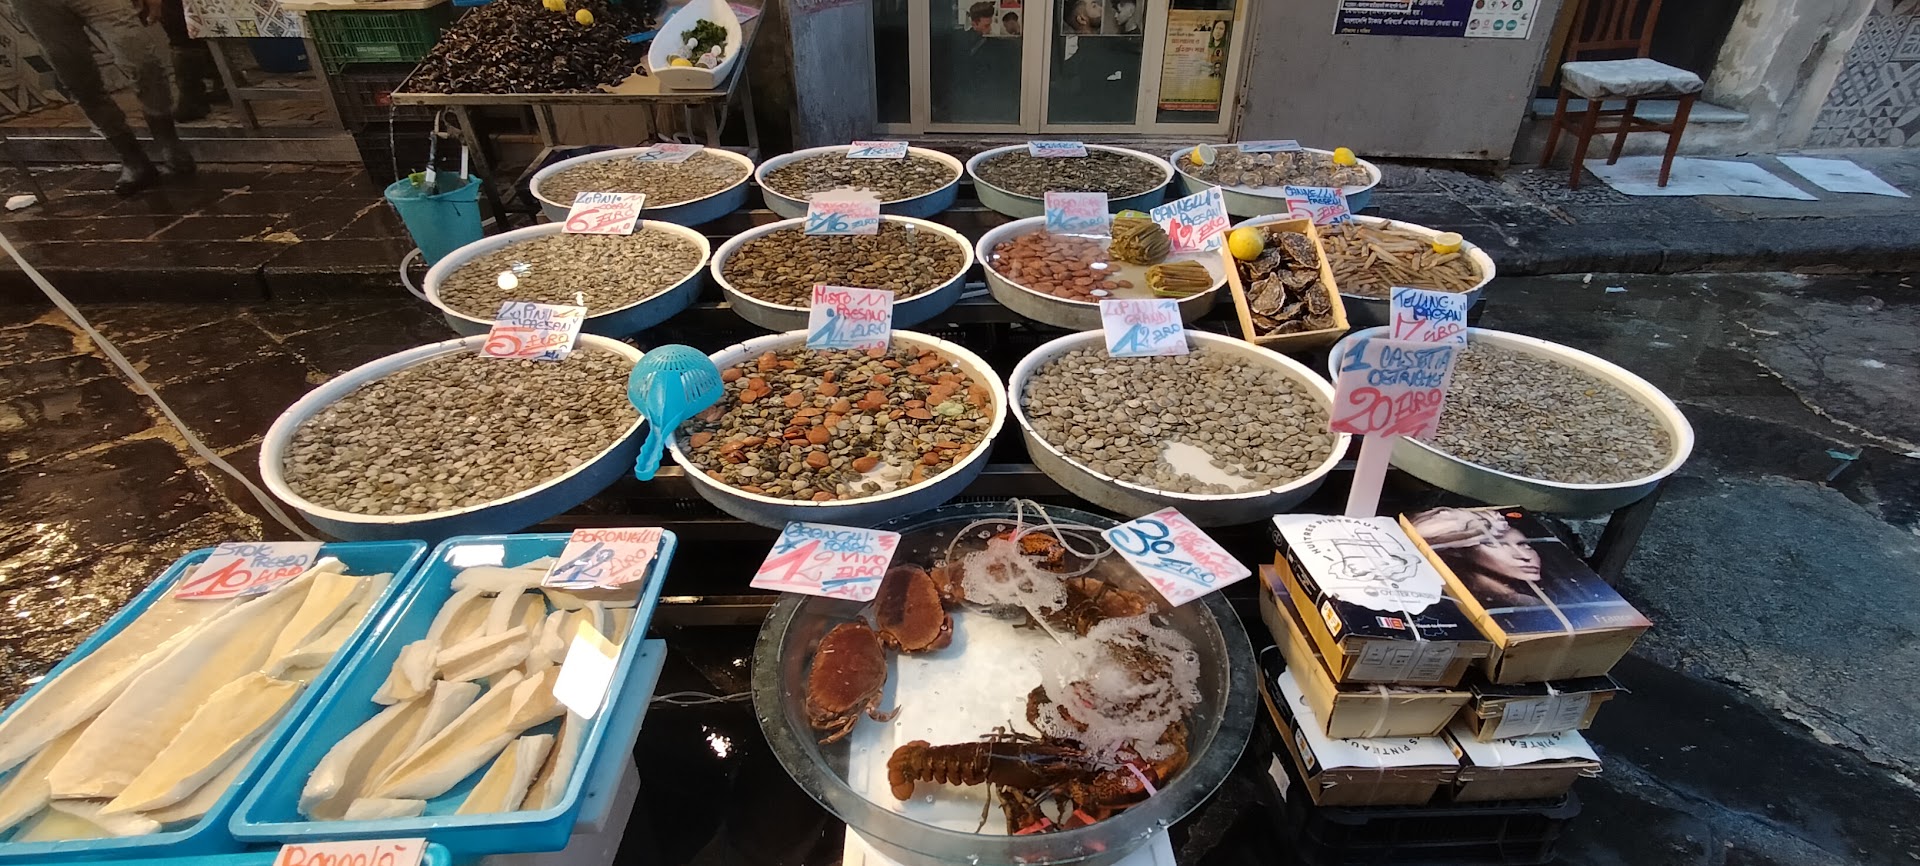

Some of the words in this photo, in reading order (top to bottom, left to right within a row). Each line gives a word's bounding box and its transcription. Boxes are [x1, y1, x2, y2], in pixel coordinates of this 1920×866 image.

[566, 209, 600, 232] 6
[484, 327, 536, 357] 5
[1110, 322, 1152, 353] 12
[1342, 339, 1372, 372] 1
[1330, 386, 1393, 434] 20
[1108, 518, 1175, 557] 30
[1303, 525, 1321, 555] HUITRES
[1318, 518, 1381, 531] PINTEAUX
[181, 557, 253, 595] 10
[759, 540, 836, 583] 12
